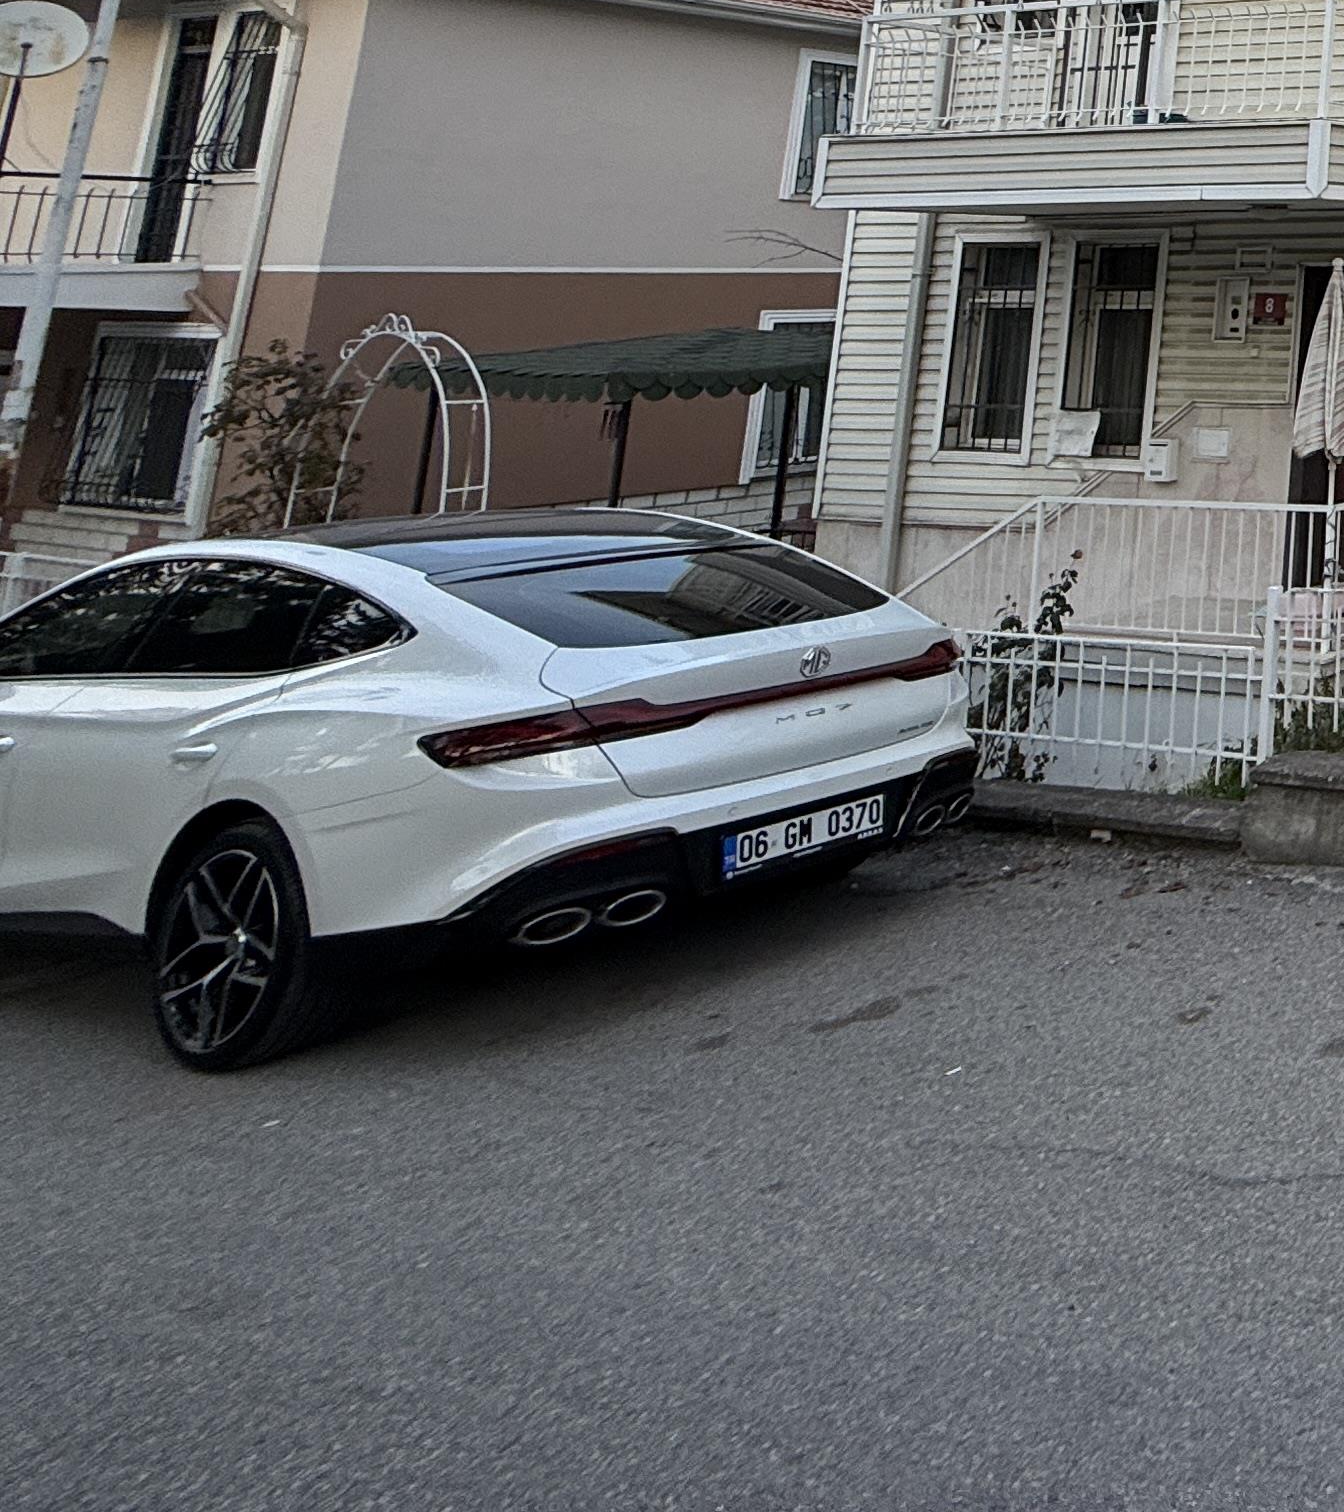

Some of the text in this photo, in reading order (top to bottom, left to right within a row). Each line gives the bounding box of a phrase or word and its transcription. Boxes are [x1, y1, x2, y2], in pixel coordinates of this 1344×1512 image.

[1265, 298, 1274, 313] 8
[801, 646, 831, 678] MG
[739, 830, 768, 863] 06
[784, 817, 813, 850] GM
[828, 799, 881, 837] 0370
